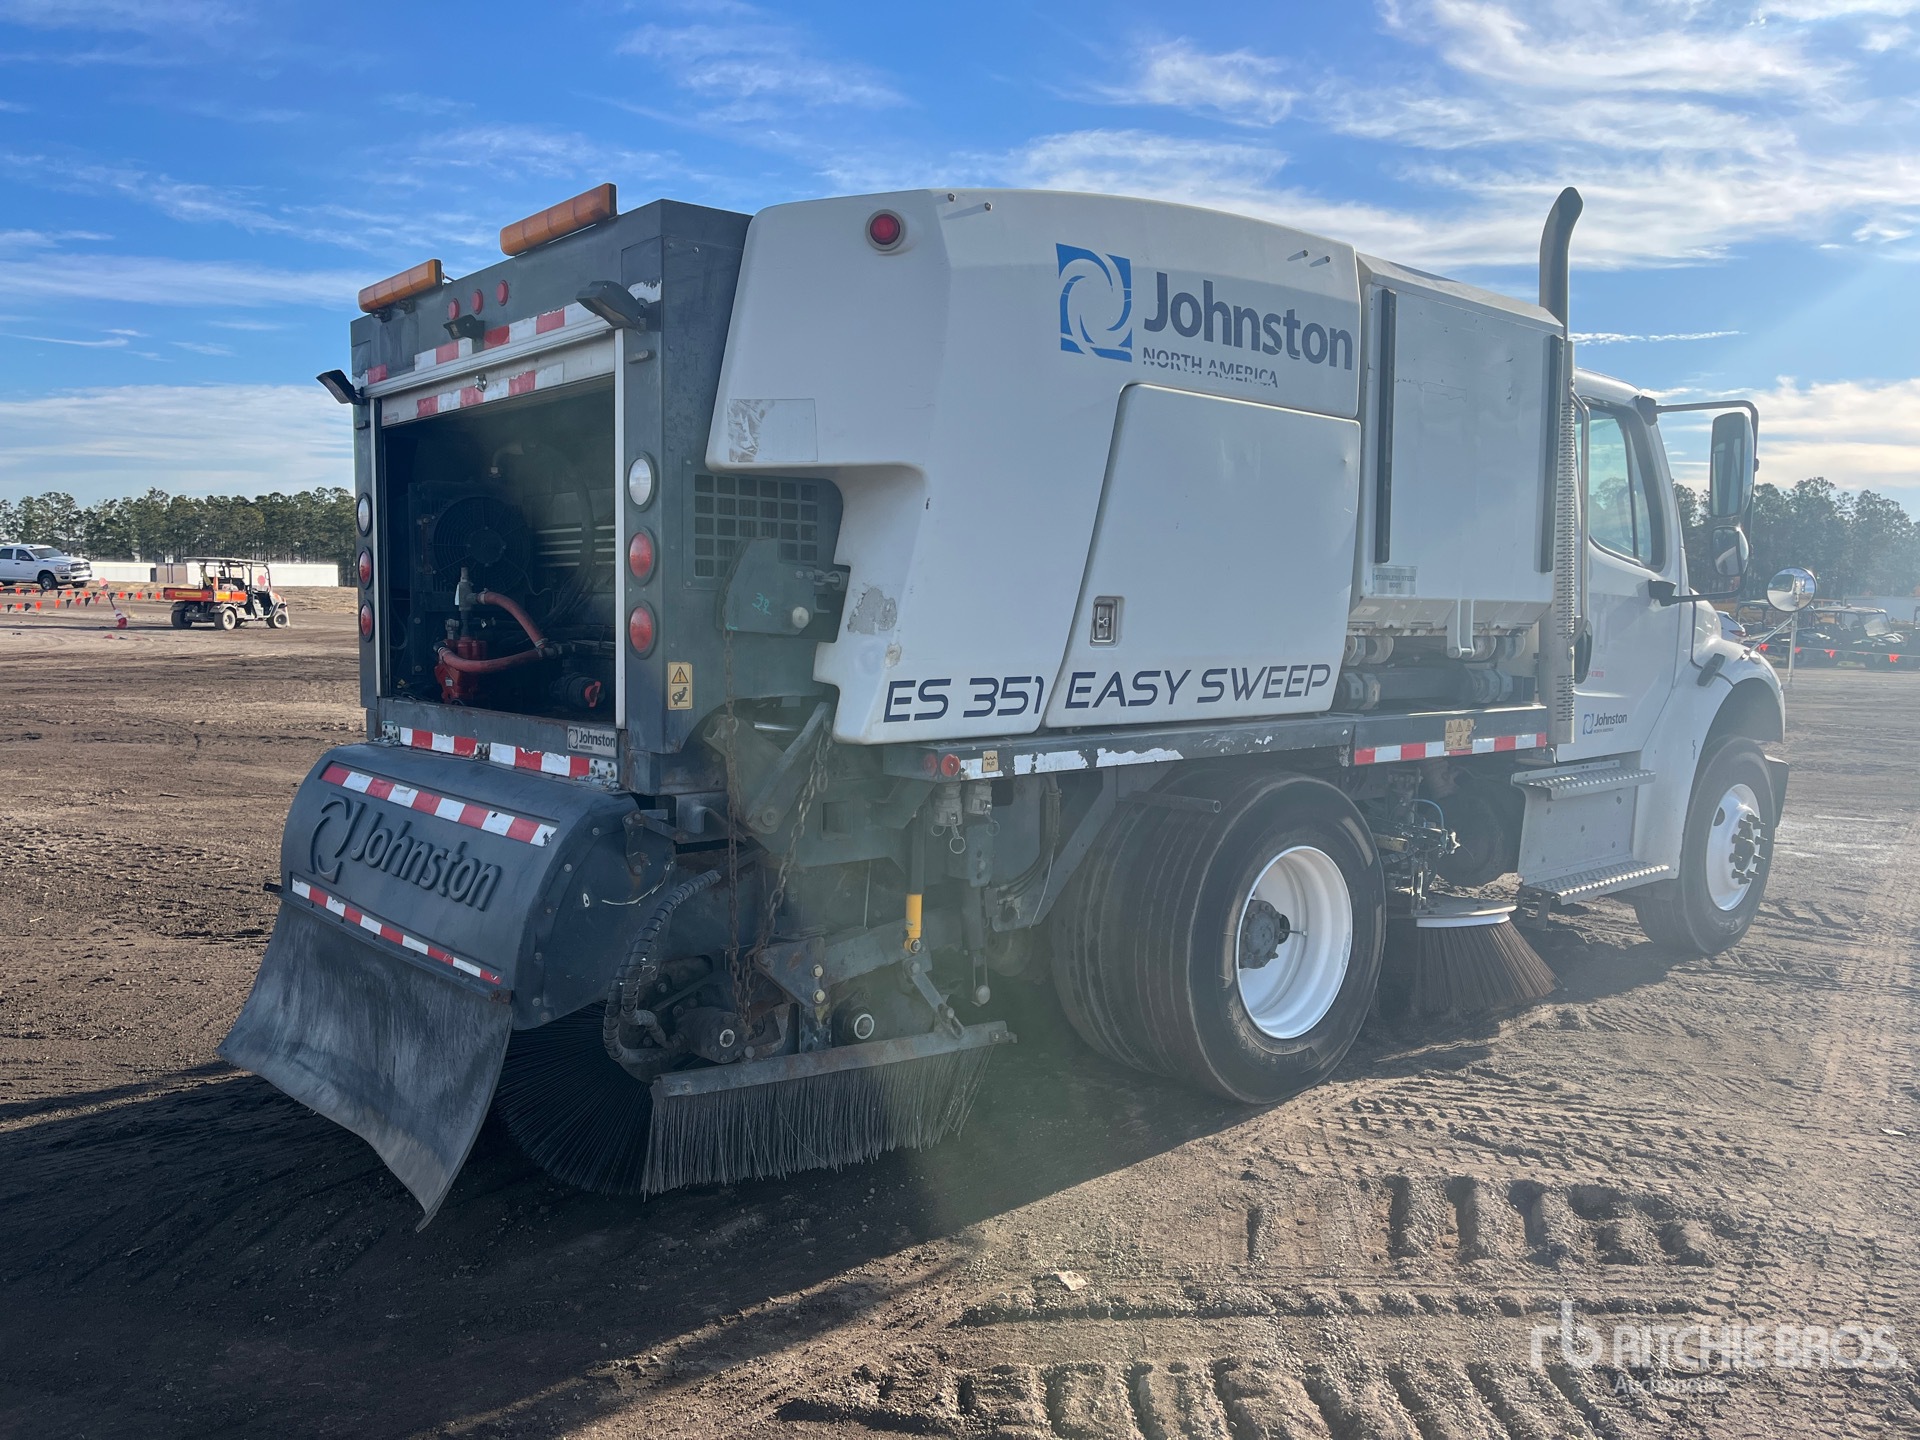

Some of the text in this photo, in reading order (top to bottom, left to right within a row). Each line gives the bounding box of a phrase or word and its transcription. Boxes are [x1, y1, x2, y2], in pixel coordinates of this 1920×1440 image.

[1143, 271, 1353, 371] Johnston
[883, 664, 1331, 723] ES 351 EASY SWEEP
[1594, 712, 1628, 727] Johnston
[579, 730, 616, 748] Johnston
[350, 812, 502, 912] Johnston
